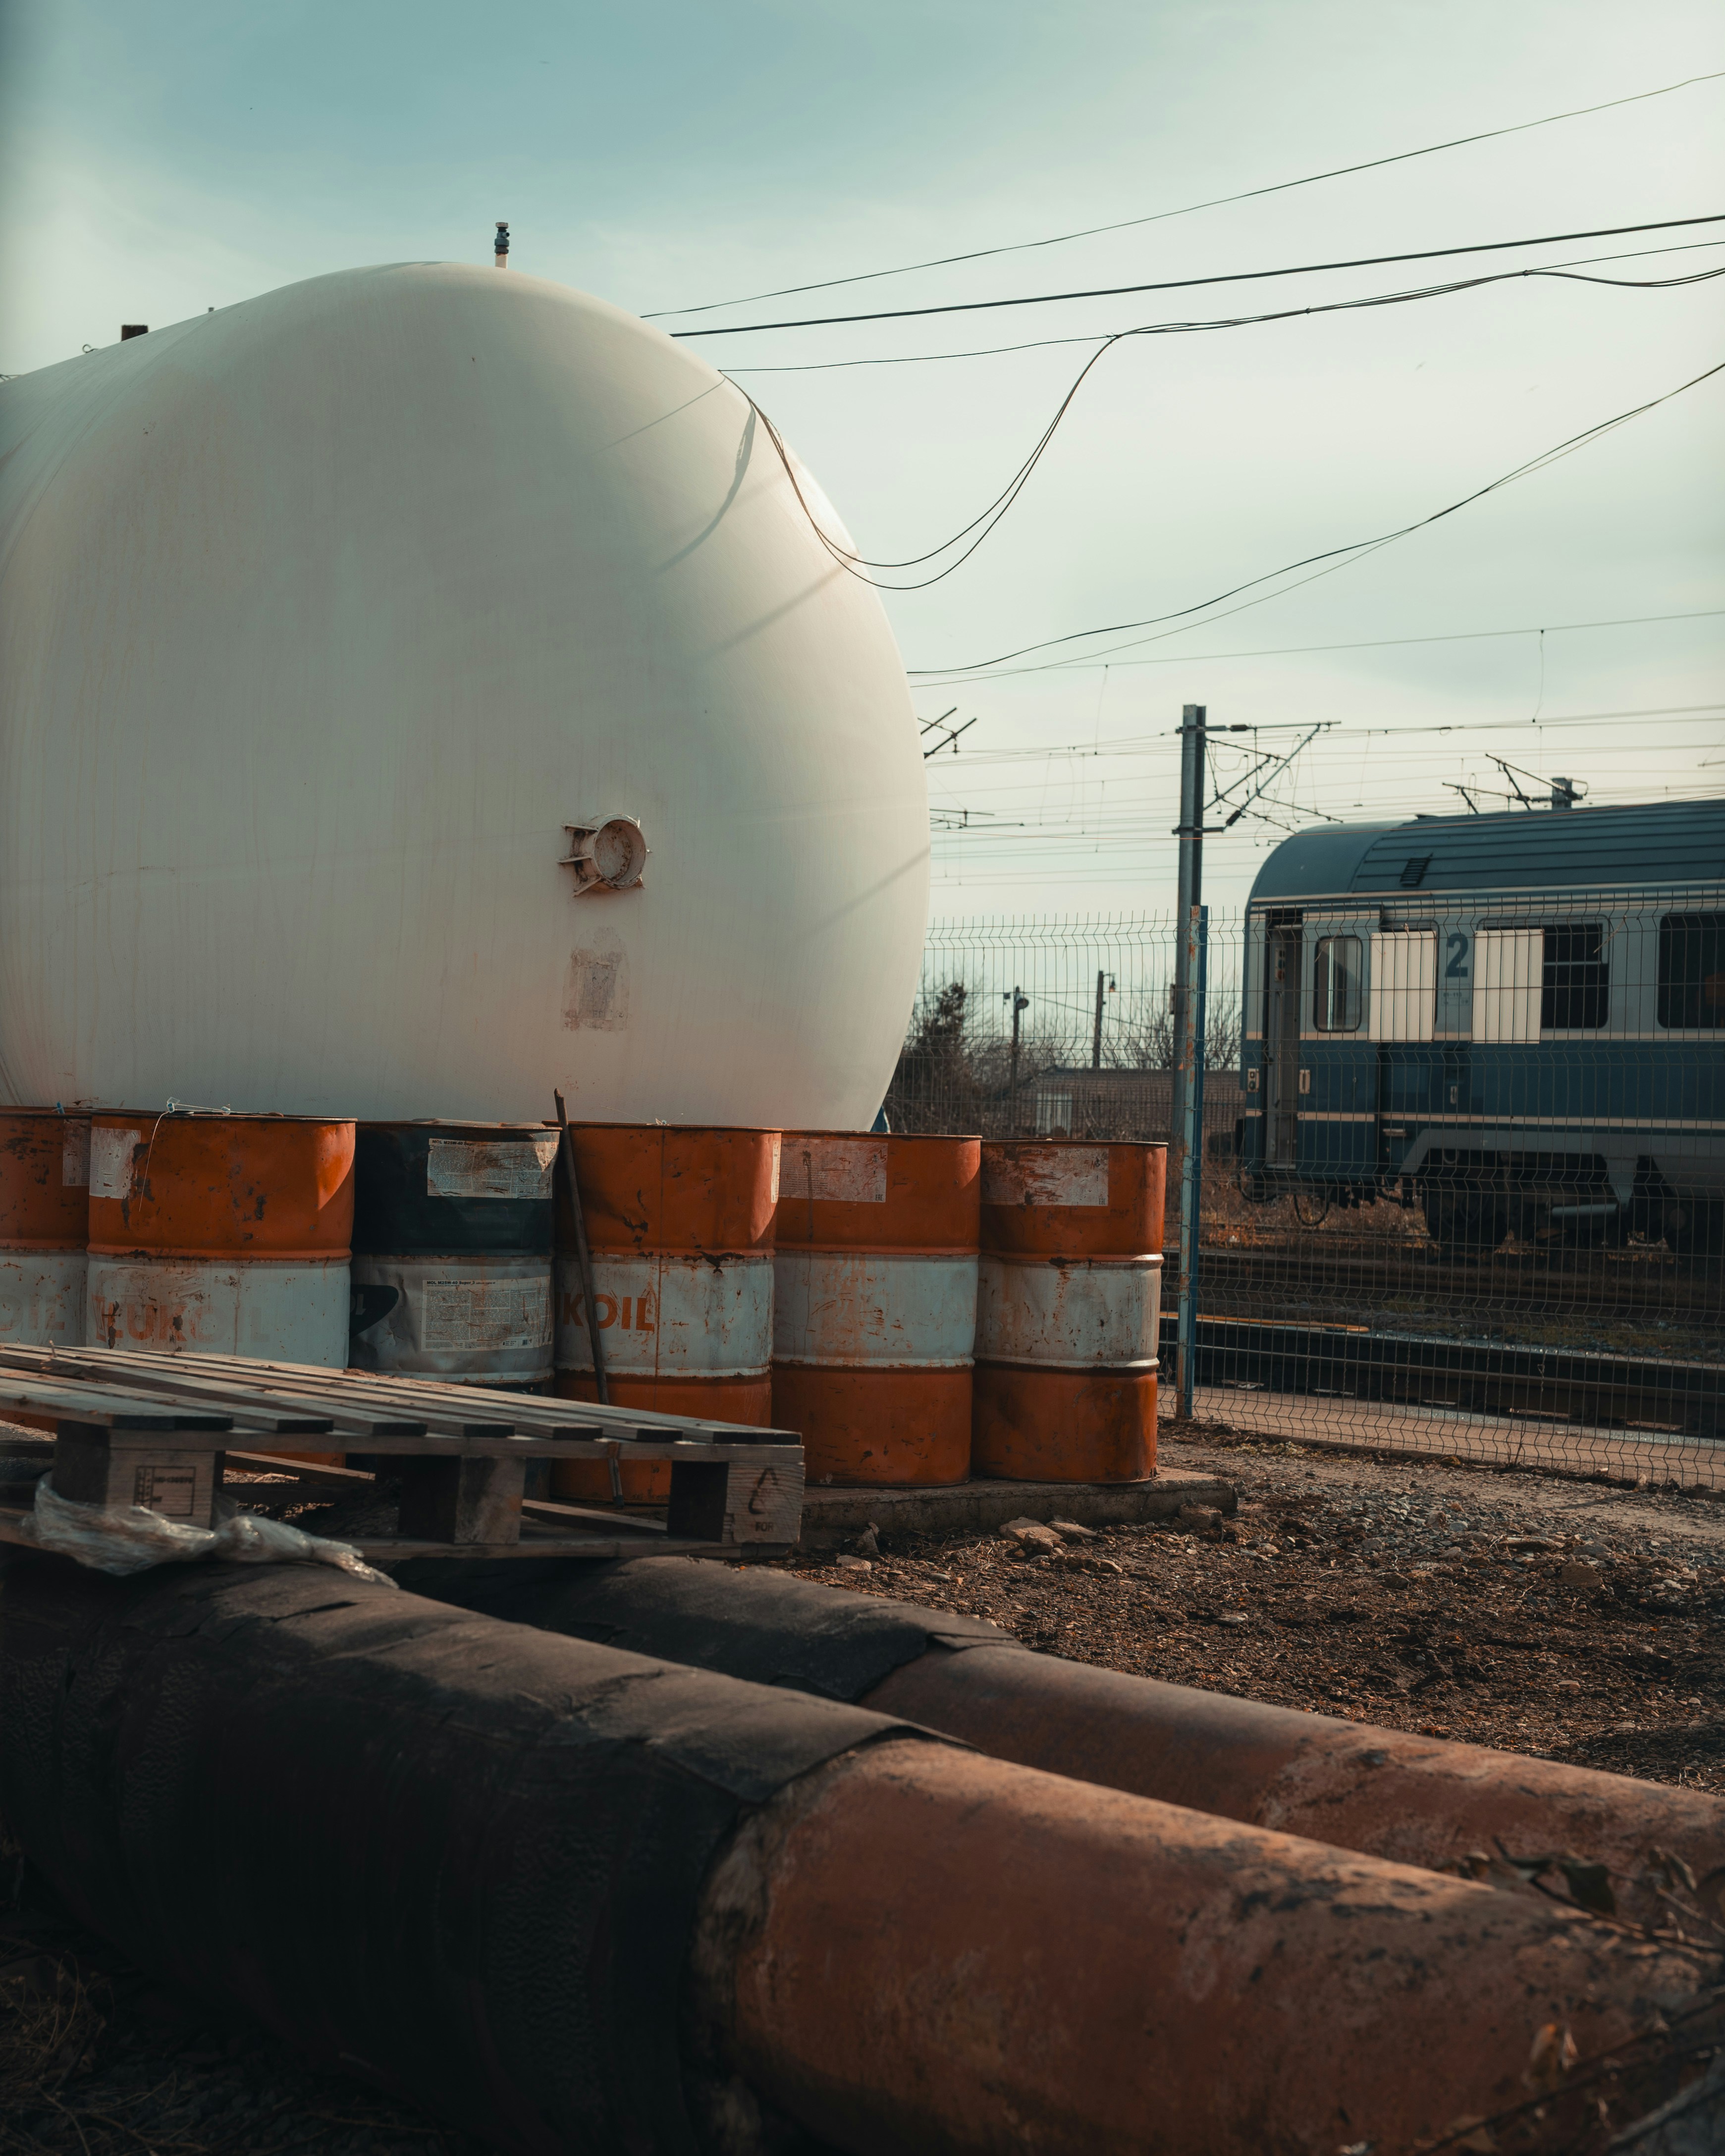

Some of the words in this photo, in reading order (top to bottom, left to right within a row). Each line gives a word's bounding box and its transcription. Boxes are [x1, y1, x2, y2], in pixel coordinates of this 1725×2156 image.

[1445, 932, 1468, 977] 2
[108, 1302, 270, 1344] LUKOIL
[554, 1292, 655, 1332] KOIL
[755, 1522, 774, 1532] FOR
